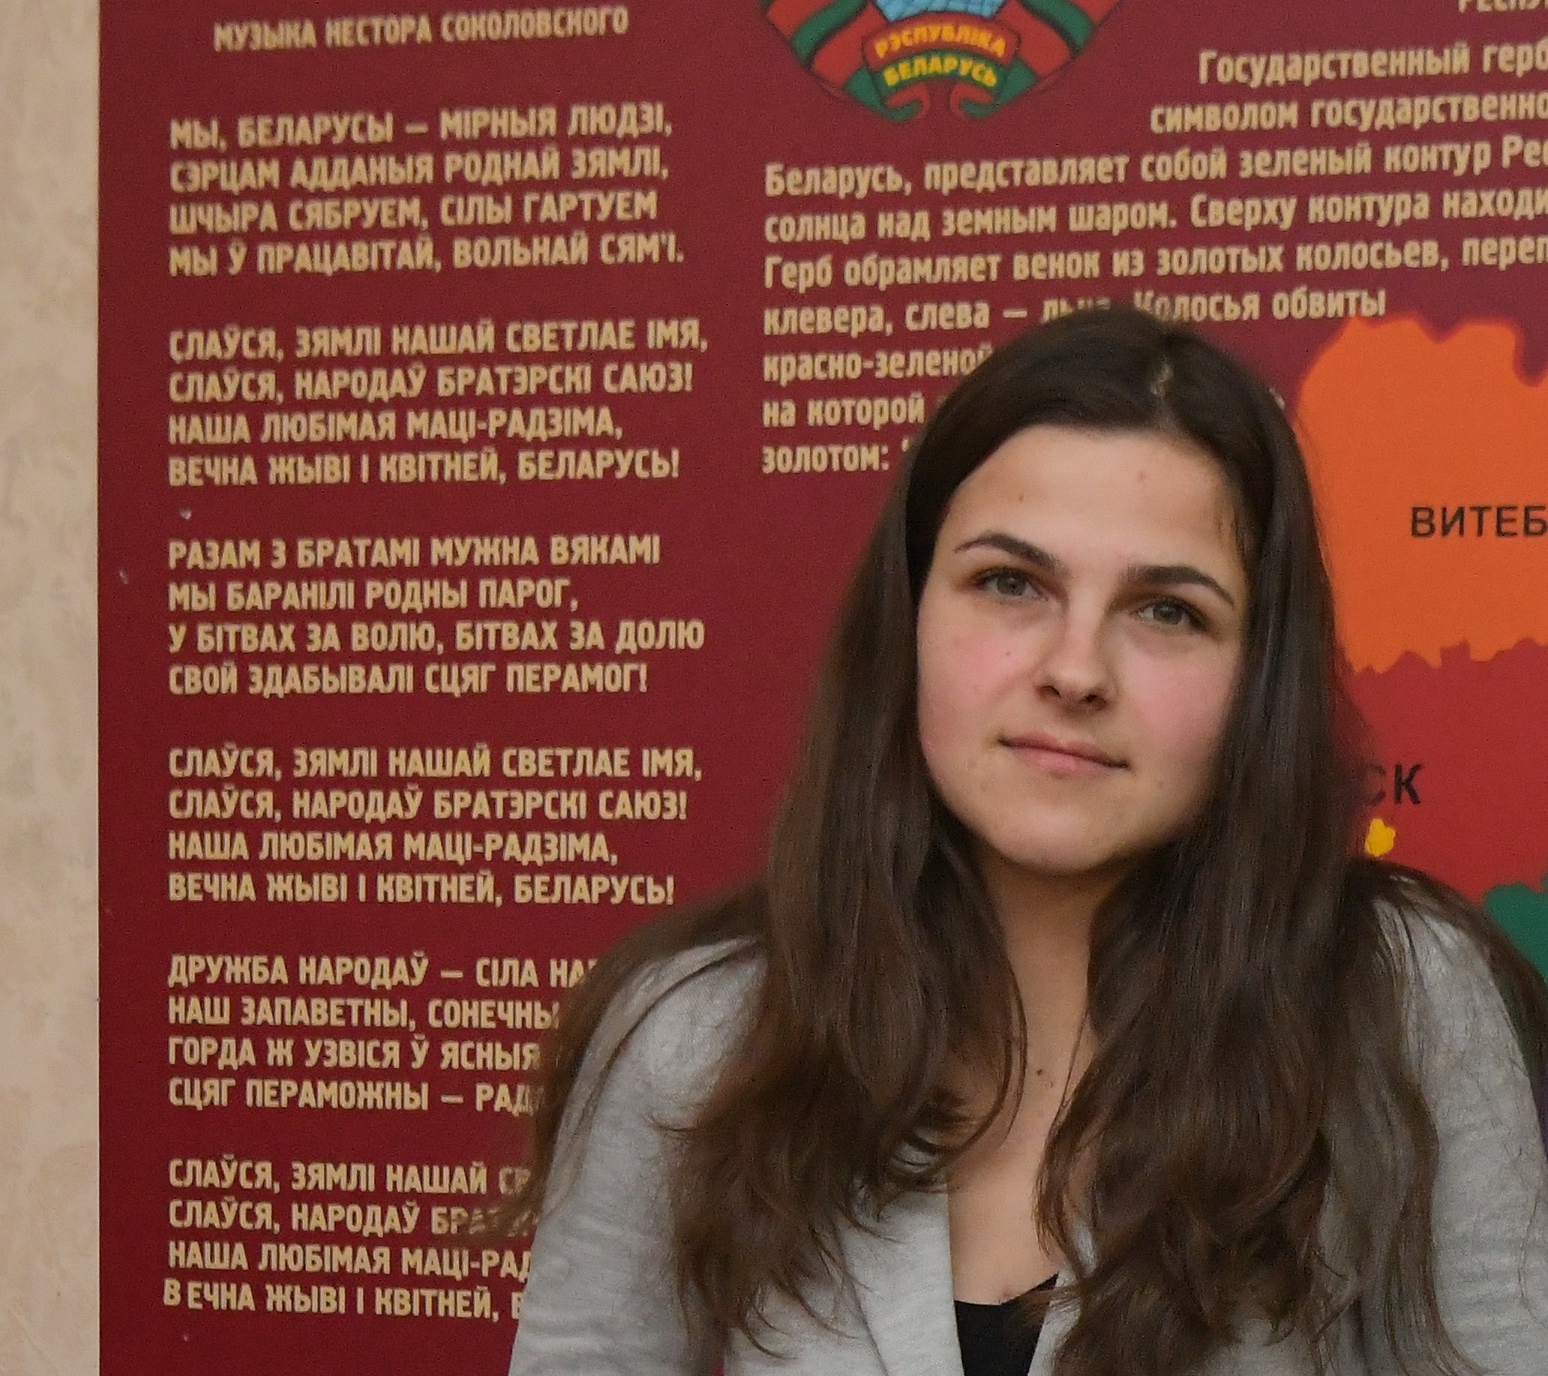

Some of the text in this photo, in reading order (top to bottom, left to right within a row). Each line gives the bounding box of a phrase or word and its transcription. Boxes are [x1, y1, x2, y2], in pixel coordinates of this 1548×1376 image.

[213, 5, 630, 52] МУЗЫКА НЕСТОРА СОКОЛОВСКОГО
[874, 21, 1008, 59] РЭСПУБЛІКА
[883, 55, 999, 87] БЕЛАРУСЬ
[1199, 41, 1471, 89] Государственный
[170, 101, 673, 151] МЫ, БЕЛАРУСЫ МІРНЫЯ ЛЮДЗІ,
[1150, 101, 1299, 134] символом
[170, 144, 669, 195] СЭРЦАМ АДДАНЫЯ РОДНАЙ ЗЯМЛІ,
[765, 162, 912, 199] Беларусь,
[924, 154, 1130, 196] представляет
[1140, 146, 1228, 182] собой
[1239, 141, 1372, 179] зеленый
[1384, 141, 1492, 177] контур
[169, 189, 658, 235] ШЧЫРА СЯБРУЕМ, СІЛЫ ГАРТУЕМ
[764, 211, 866, 245] солнца
[877, 210, 931, 242] над
[942, 205, 1057, 237] земным
[1068, 201, 1177, 236] шаром.
[1190, 193, 1298, 232] Сверху
[1308, 191, 1431, 228] контура
[169, 245, 218, 277] МЫ
[228, 241, 248, 275] Ў
[257, 234, 442, 277] ПРАЦАВІТАЙ,
[452, 229, 589, 269] ВОЛЬНАЙ
[764, 254, 833, 294] Герб
[844, 252, 1002, 291] обрамляет
[1012, 250, 1101, 281] венок
[1112, 248, 1145, 277] из
[1156, 244, 1284, 276] золотых
[1296, 239, 1449, 272] колосьев,
[763, 304, 893, 339] клевера,
[905, 300, 990, 331] слева
[1271, 285, 1387, 320] обвиты
[762, 391, 925, 431] на которой
[762, 444, 890, 474] золотом:
[168, 533, 661, 570] РАЗАМ З БРАТАМІ МУЖНА ВЯКАМІ
[168, 577, 579, 614] МЫ БАРАНІЛІ РОДНЫ ПАРОГ,
[168, 618, 705, 655] У БІТВАХ ЗА ВОЛЮ, БІТВАХ ЗА ДОЛЮ
[169, 660, 648, 699] СВОЙ ЗДАБЫВАЛІ СЦЯГ ПЕРАМОГ!
[168, 831, 618, 867] НАША ЛЮБІМАЯ МАЦІ-РАДЗІМА,
[168, 1077, 429, 1111] СЦЯГ ПЕРАМОЖНЫ
